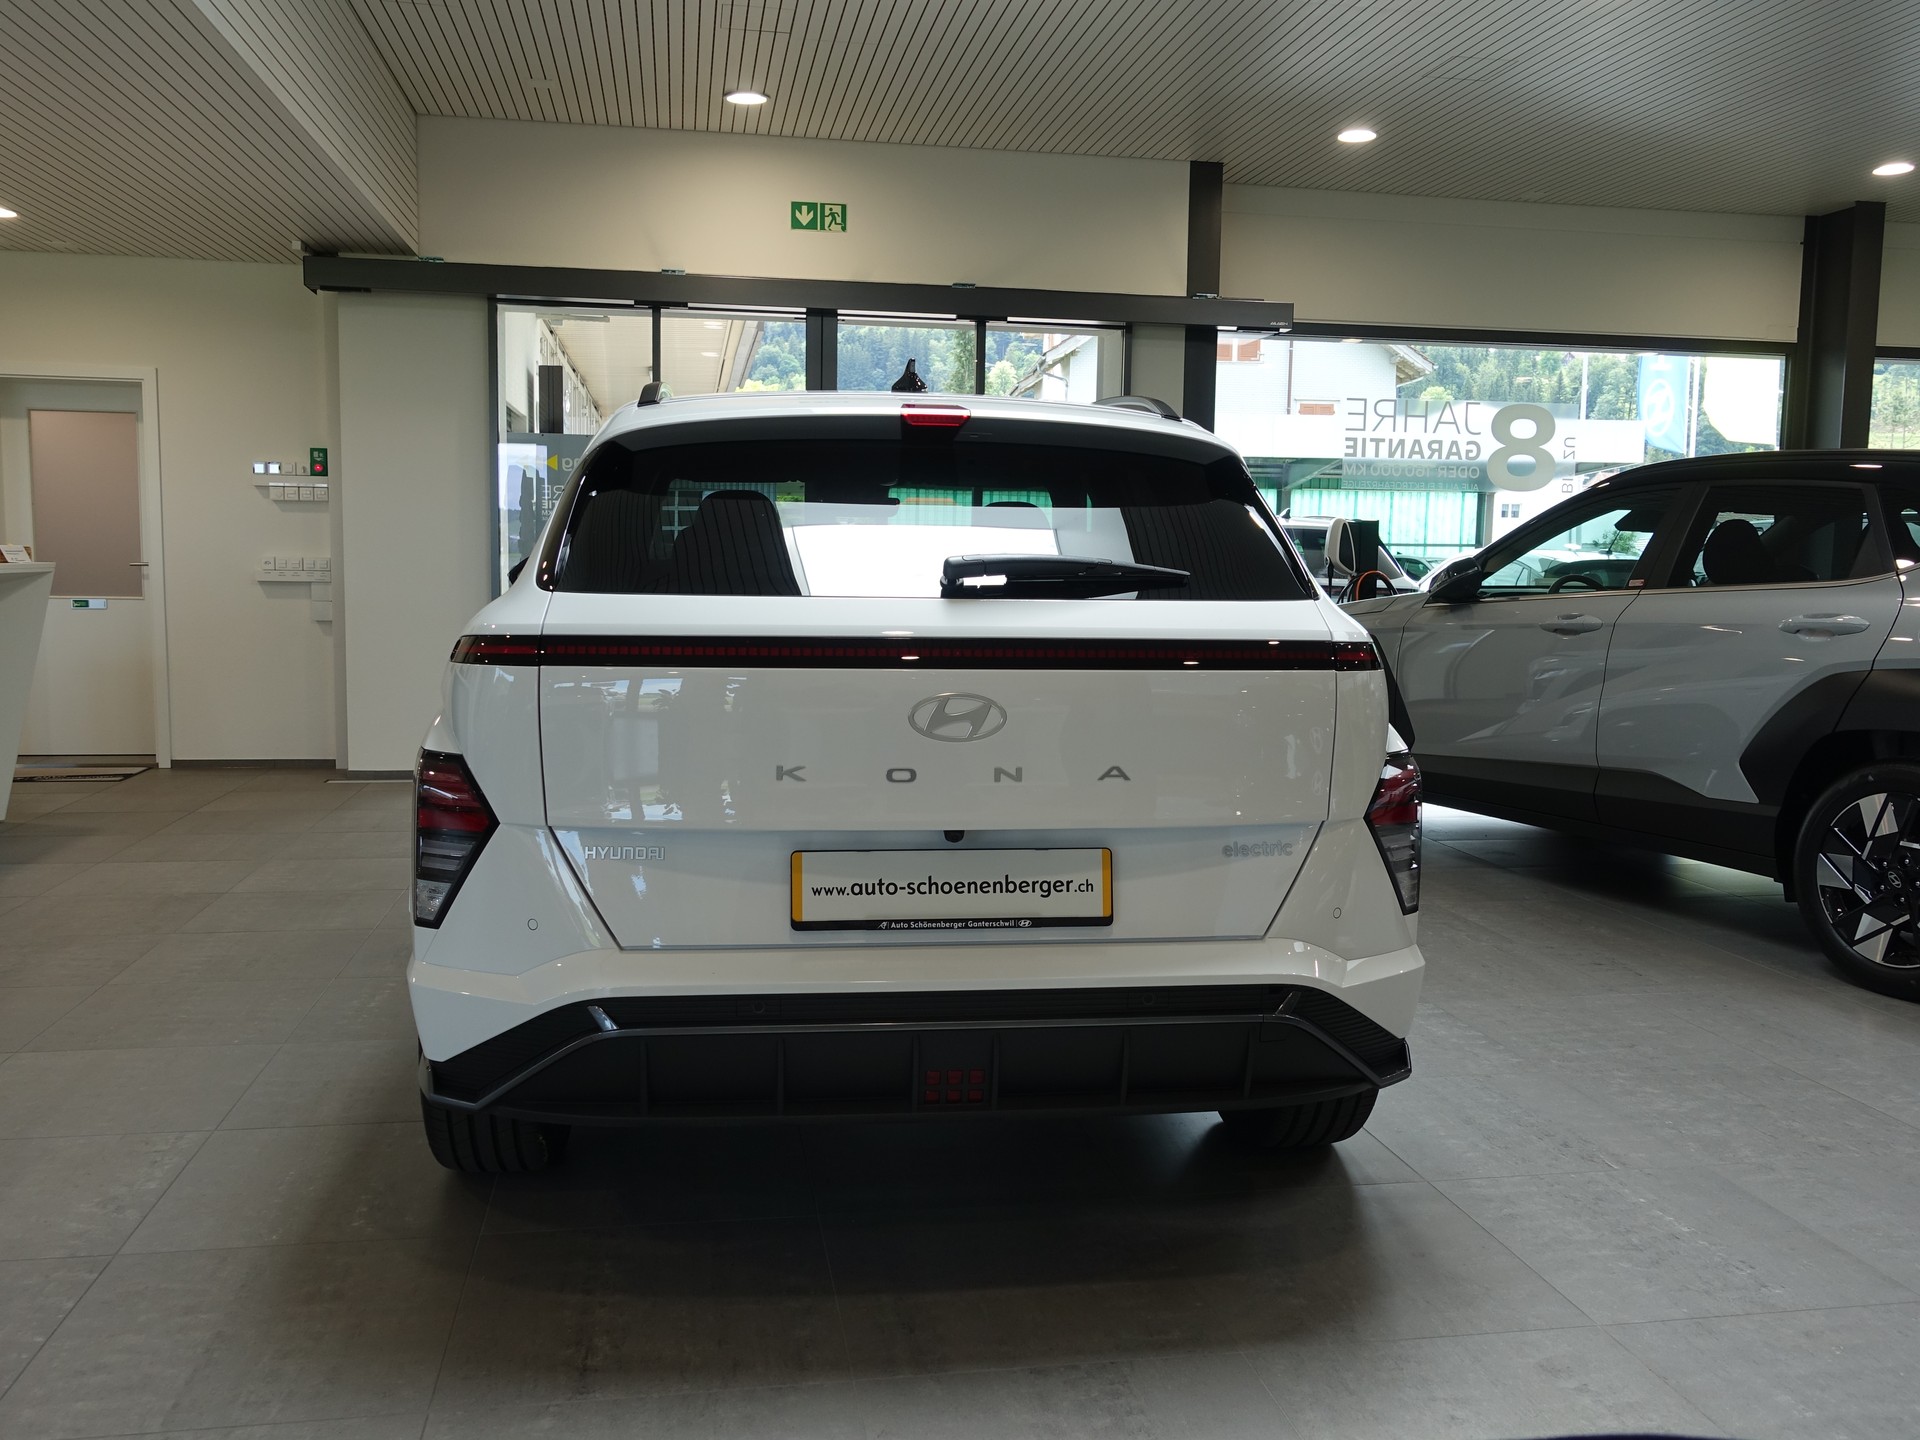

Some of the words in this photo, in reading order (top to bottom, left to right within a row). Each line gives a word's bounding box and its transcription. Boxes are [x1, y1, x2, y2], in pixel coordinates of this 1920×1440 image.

[584, 845, 665, 861] HYUNDAI
[1221, 840, 1294, 857] electric
[811, 874, 1095, 899] www.auto-schoenenberger.ch
[890, 922, 909, 930] Auto
[910, 920, 965, 930] Schönenberger
